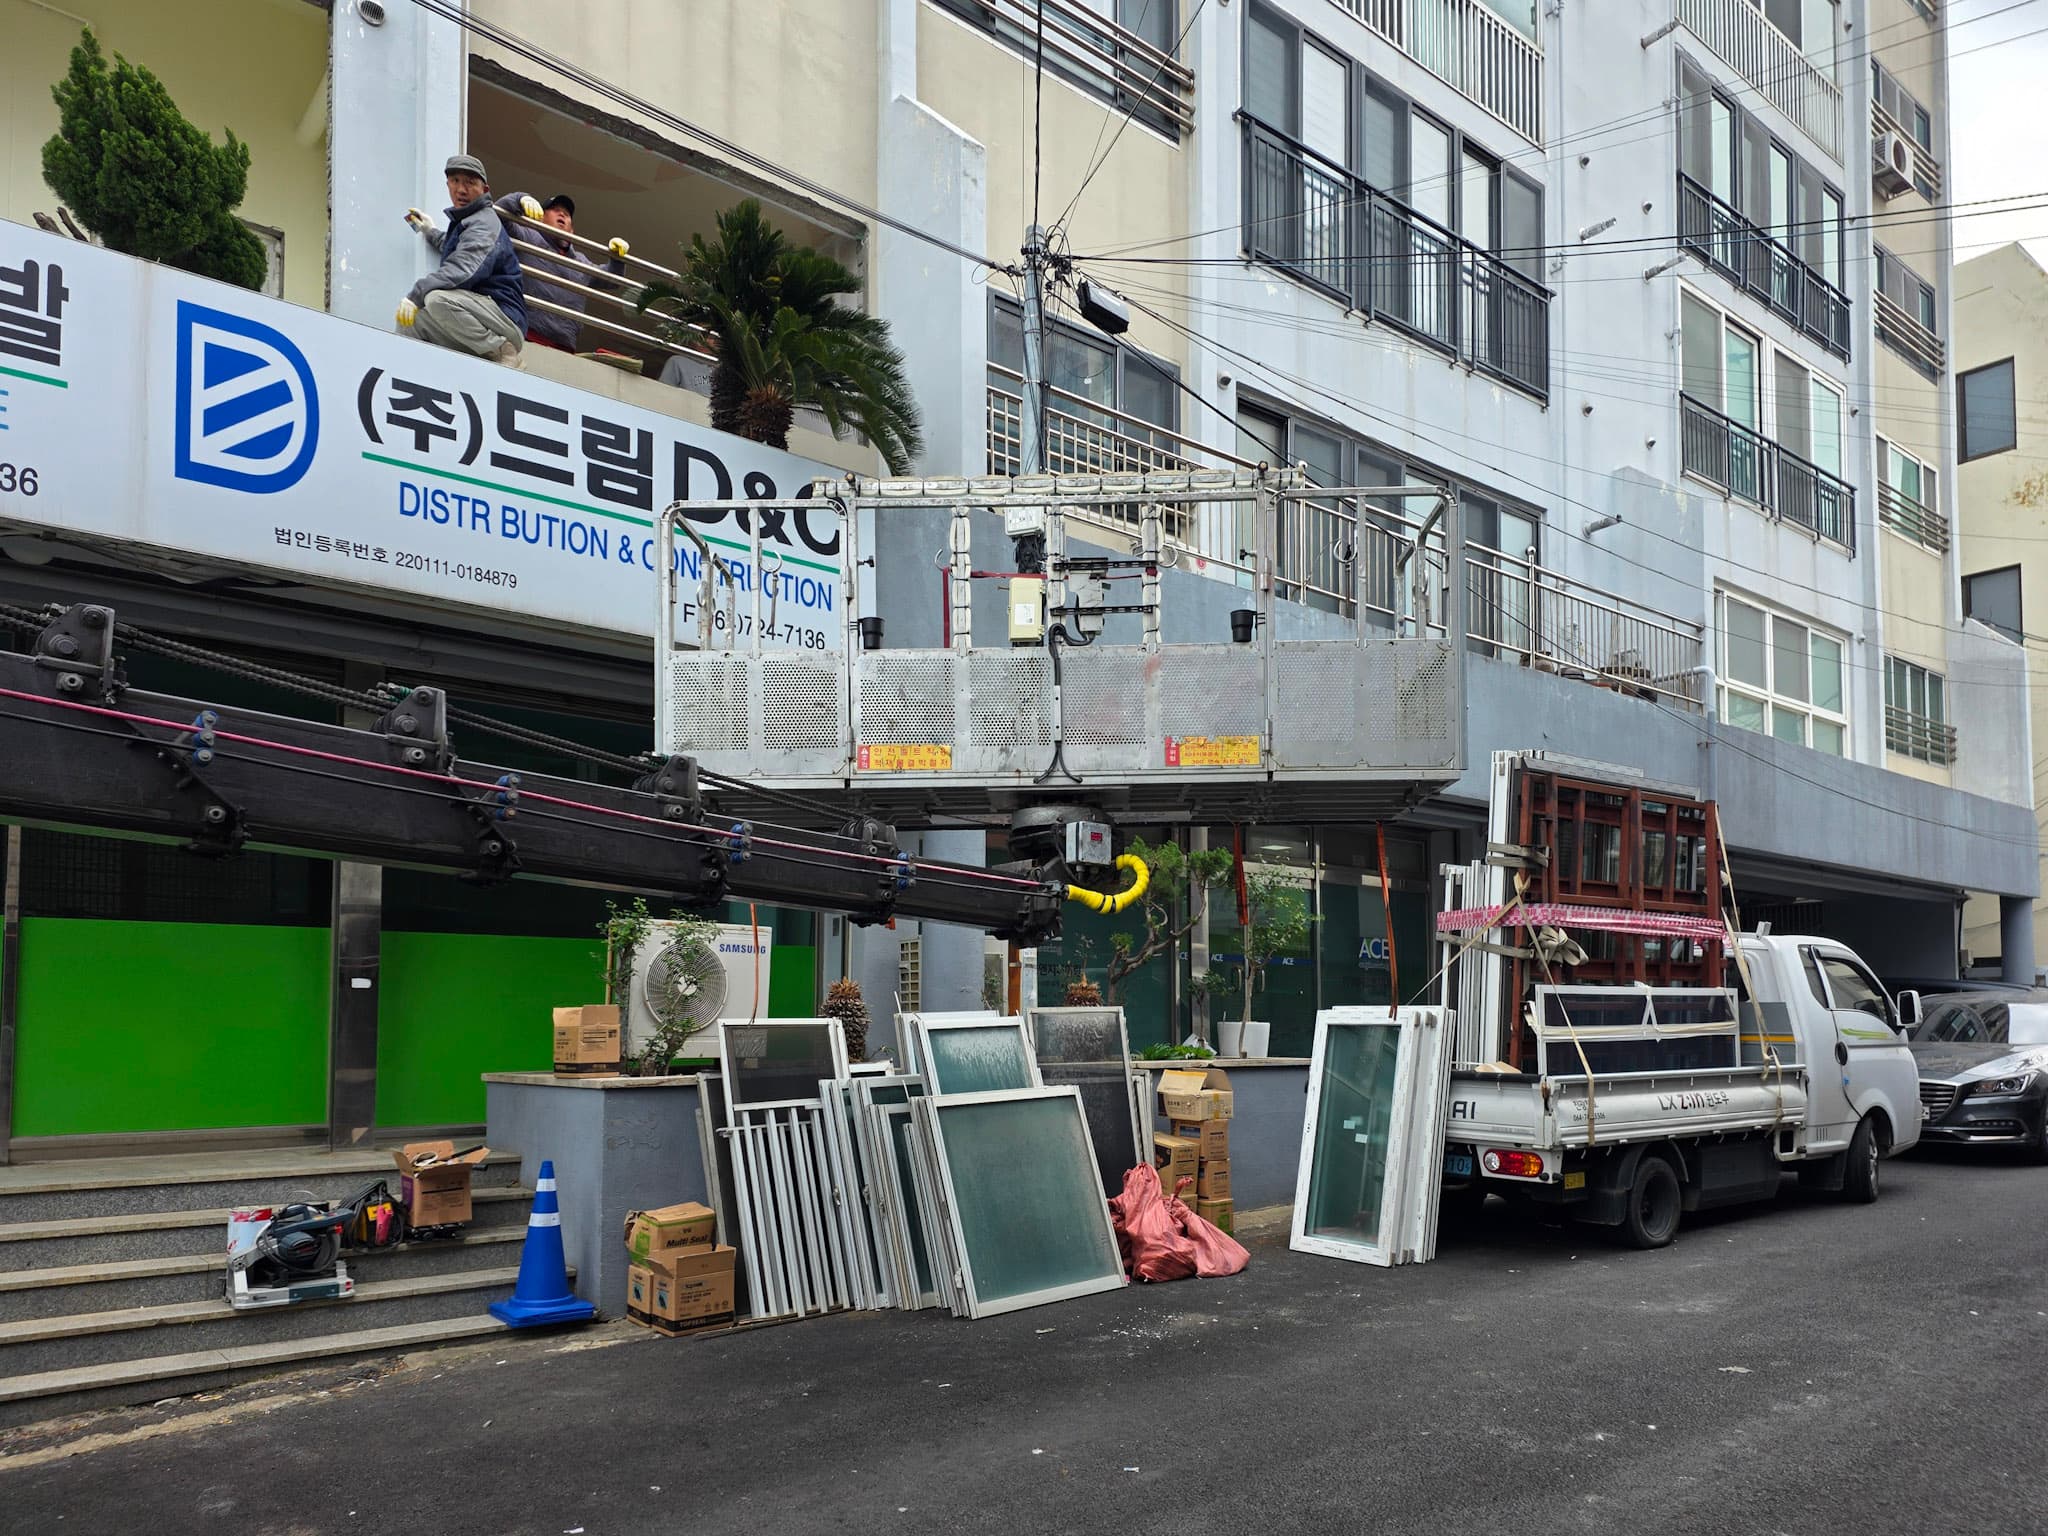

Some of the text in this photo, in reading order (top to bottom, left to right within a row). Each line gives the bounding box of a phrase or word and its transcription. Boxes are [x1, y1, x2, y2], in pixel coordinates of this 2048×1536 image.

[275, 527, 518, 589] 법인등록번호 220111-0184879
[618, 535, 635, 565] &
[1359, 938, 1389, 960] ACE
[666, 1237, 689, 1248] Multi
